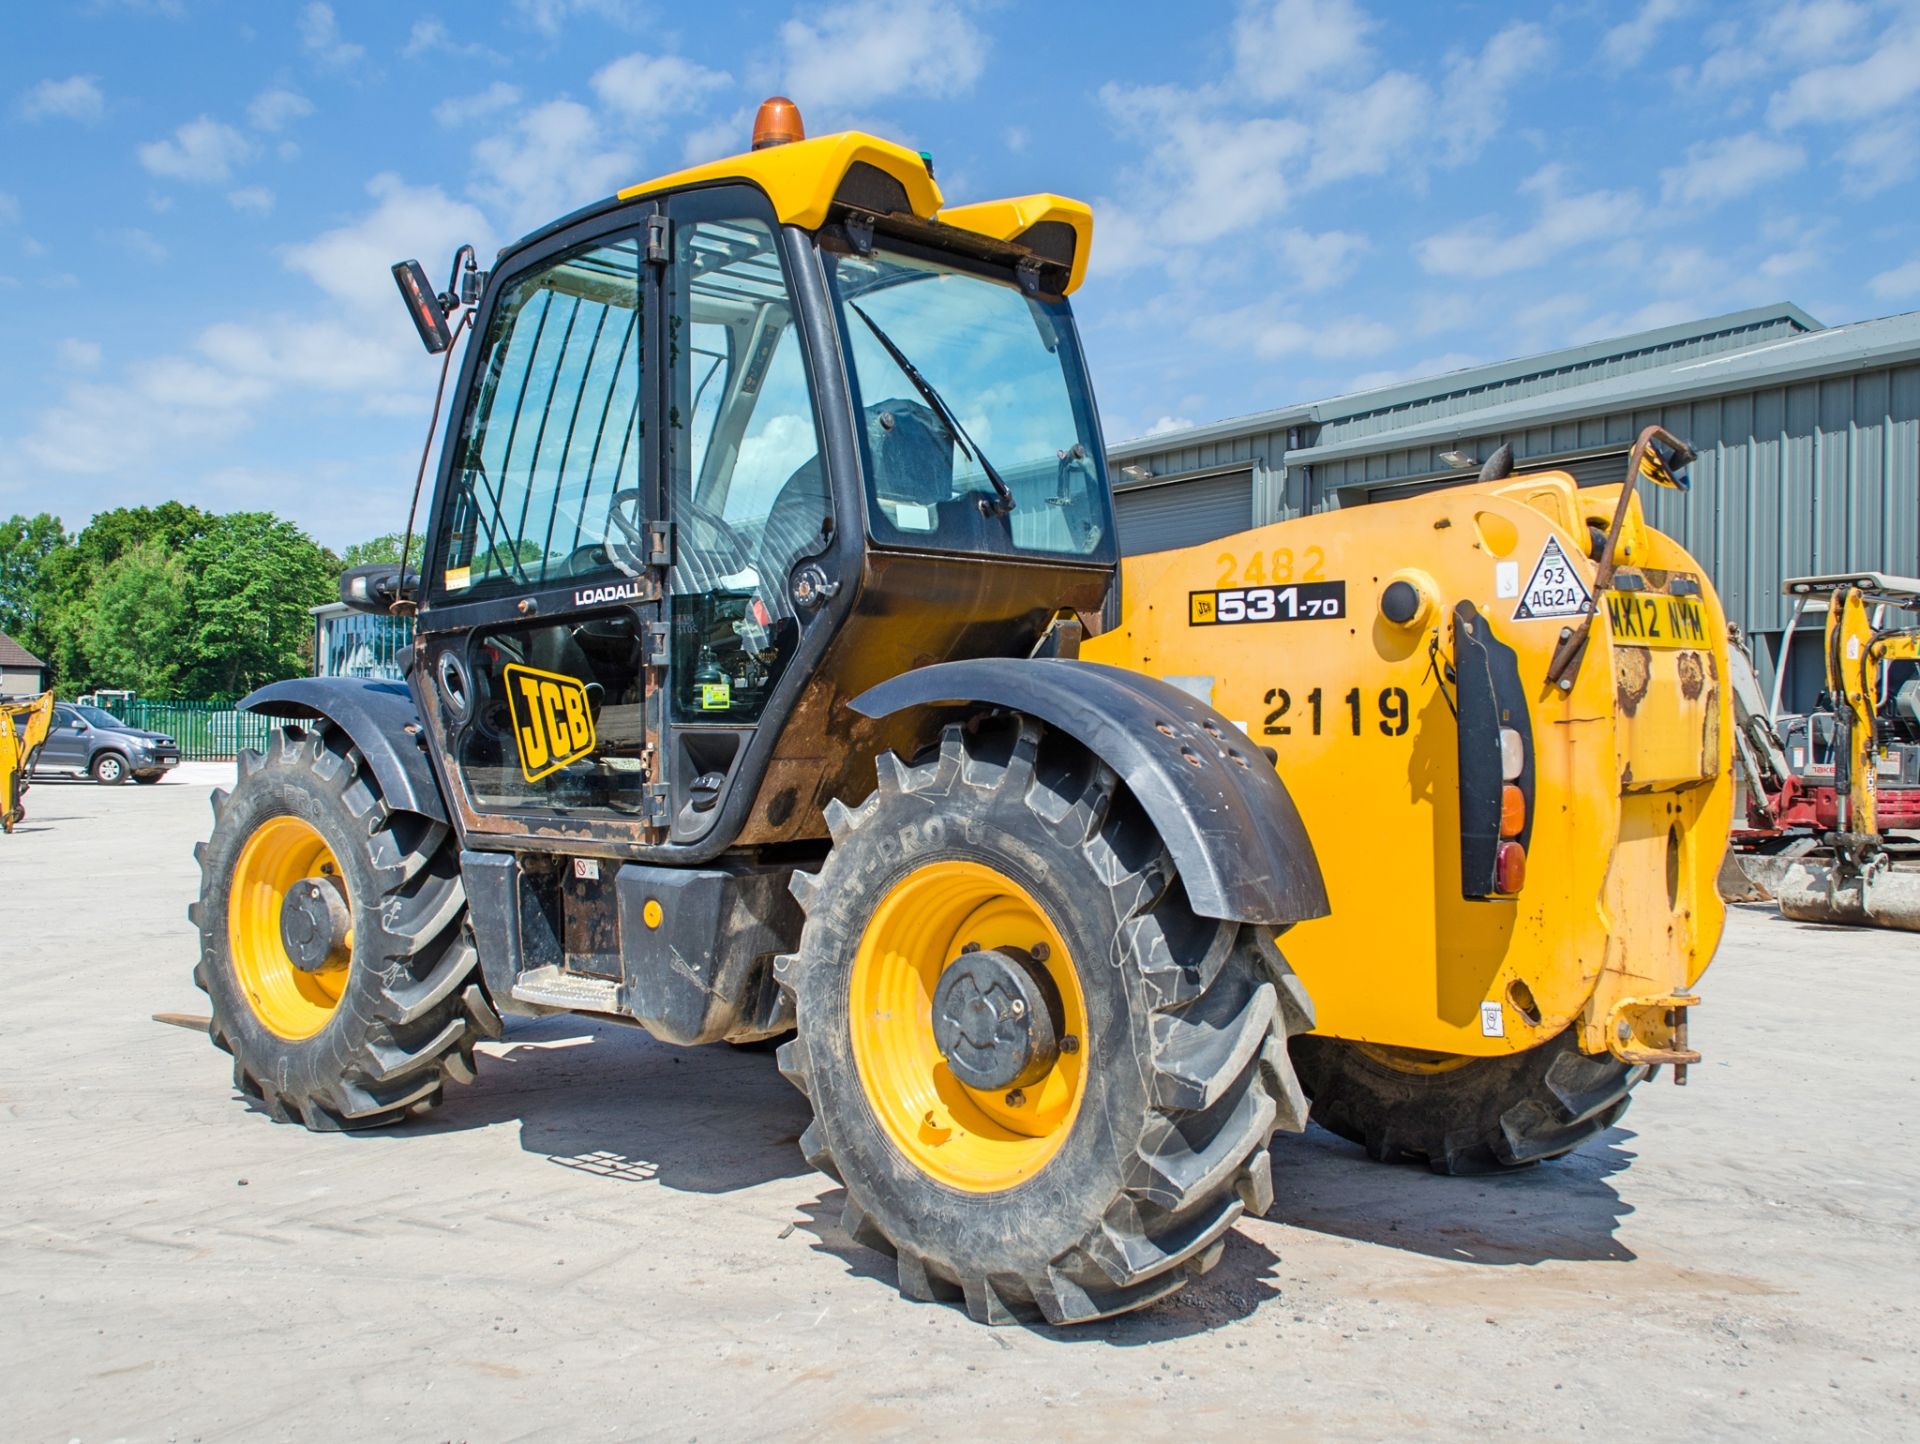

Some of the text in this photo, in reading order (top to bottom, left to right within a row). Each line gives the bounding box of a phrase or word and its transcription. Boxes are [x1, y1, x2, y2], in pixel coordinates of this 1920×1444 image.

[1216, 545, 1325, 589] 2482
[1543, 567, 1565, 586] 93
[574, 582, 644, 606] LOADALL
[1532, 588, 1577, 608] AG2A
[1607, 597, 1705, 641] MX12 NYM
[519, 676, 589, 769] JCB
[1263, 687, 1410, 737] 2119
